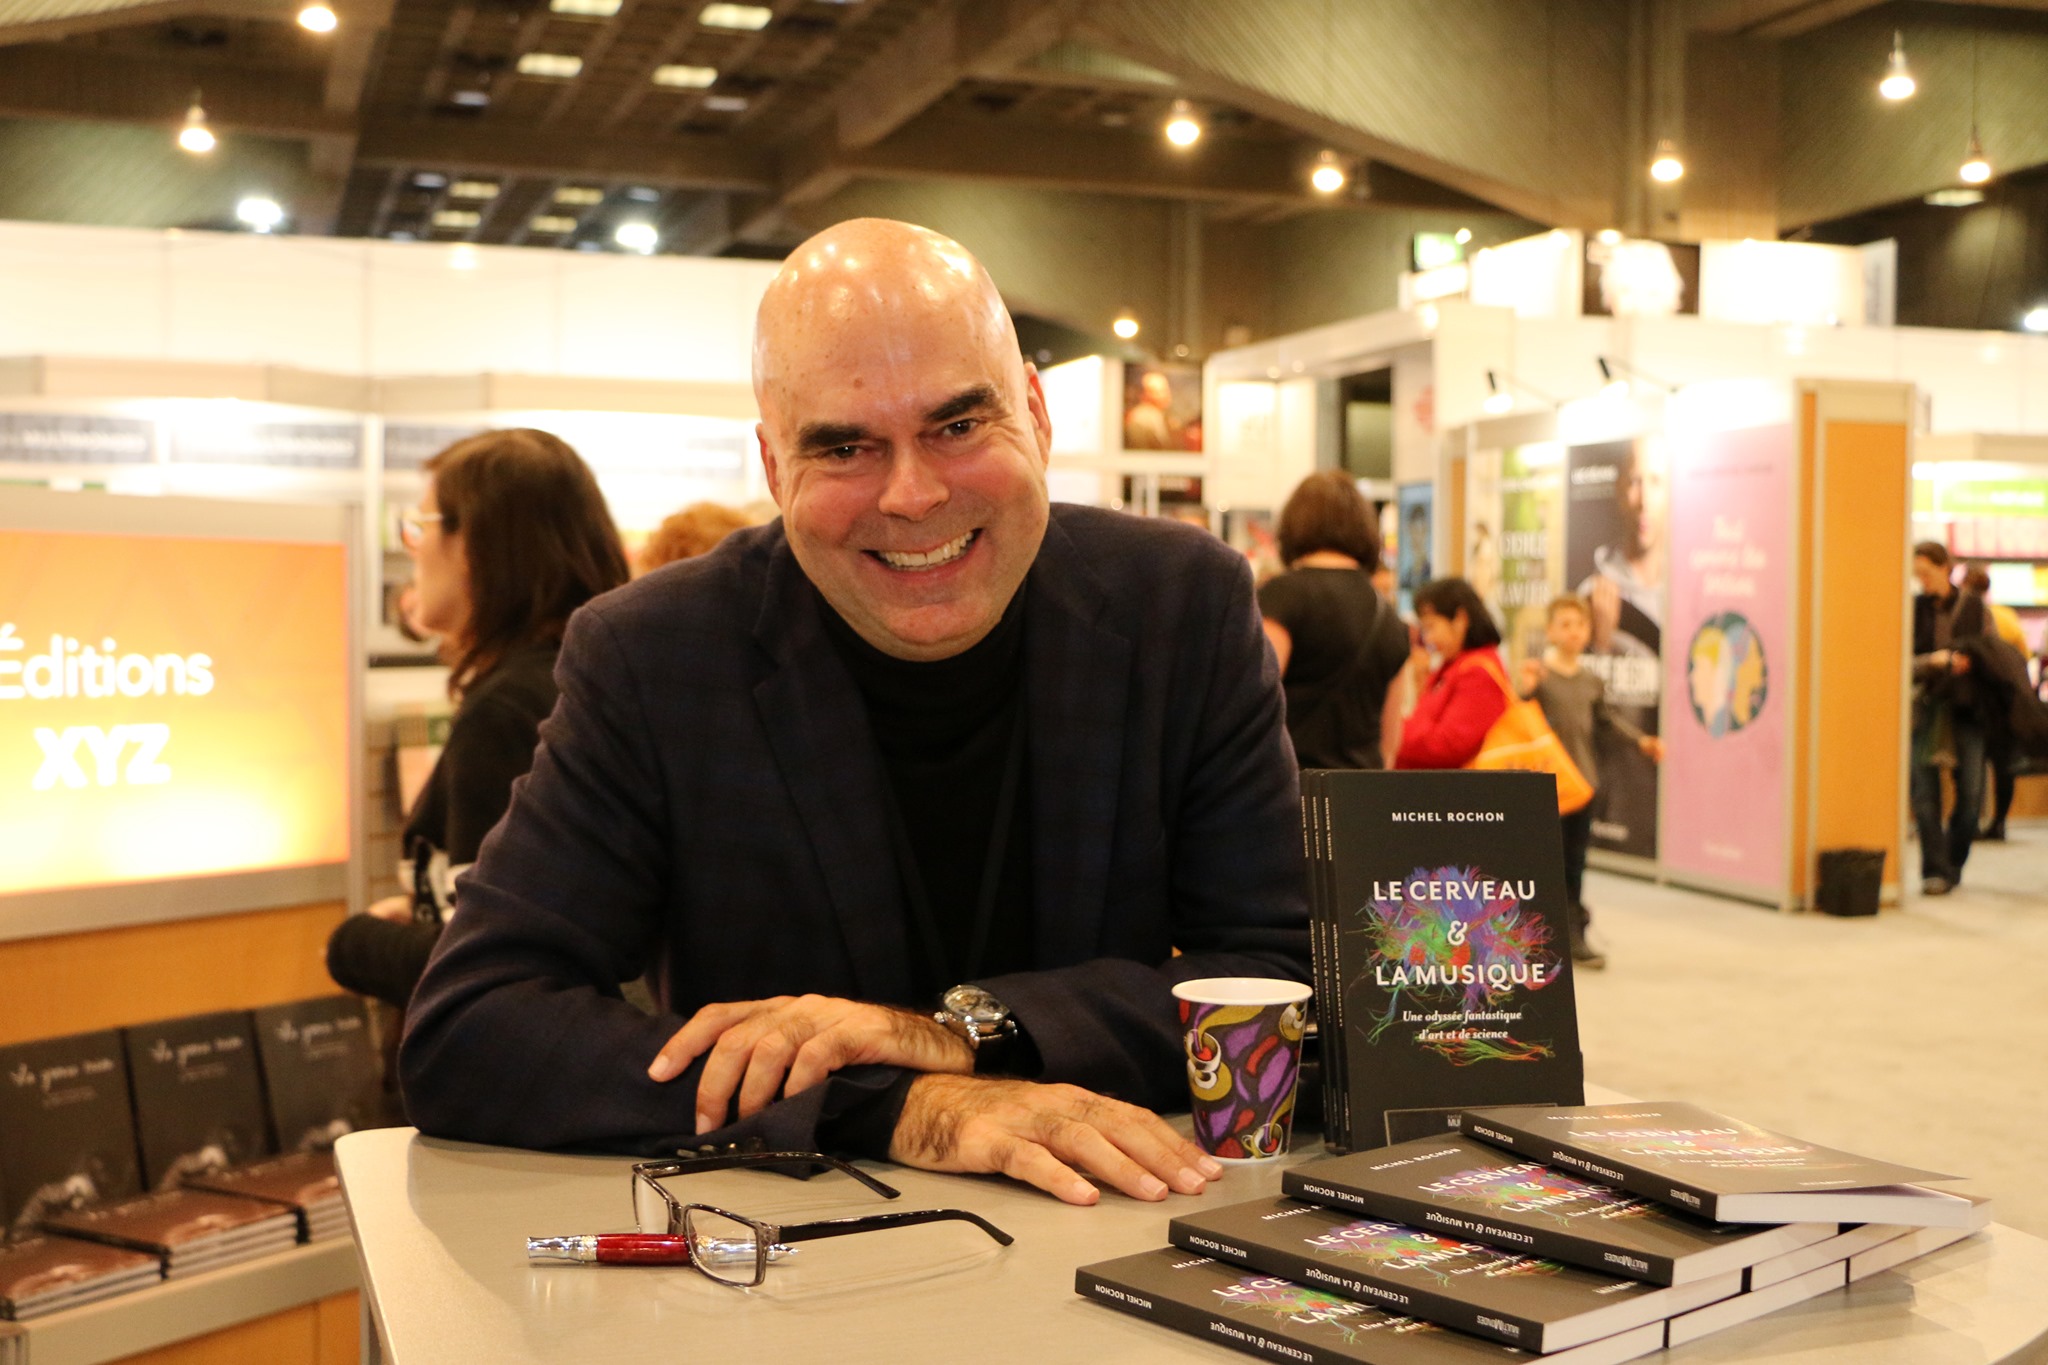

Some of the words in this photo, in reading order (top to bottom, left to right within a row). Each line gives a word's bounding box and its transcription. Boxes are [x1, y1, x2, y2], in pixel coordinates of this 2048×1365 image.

[0, 623, 214, 700] Éditions
[32, 722, 173, 791] XYZ
[1391, 812, 1442, 822] MICHEL
[1447, 812, 1505, 822] ROCHON
[1373, 880, 1402, 901] LE
[1409, 880, 1536, 901] CERVEAU
[1447, 920, 1468, 946] &
[1375, 965, 1410, 986] LA
[1415, 963, 1546, 991] MUSIQUE
[1402, 1010, 1423, 1022] Une
[1425, 1010, 1463, 1024] odyssée
[1463, 1010, 1522, 1024] fantastique
[1418, 1028, 1444, 1041] d'art
[1446, 1029, 1457, 1040] et
[1458, 1028, 1471, 1040] de
[1472, 1029, 1509, 1040] science
[1607, 1127, 1739, 1138] CERVEAU
[1370, 1158, 1414, 1171] MICHEL
[1415, 1148, 1462, 1163] ROCHON
[1552, 1151, 1578, 1166] MUSIQUE
[1591, 1164, 1617, 1179] CERVEAU
[1303, 1183, 1335, 1199] ROCHON
[1418, 1182, 1456, 1193] LE
[1516, 1181, 1545, 1191] &
[1337, 1191, 1364, 1205] MICHEL
[1260, 1206, 1311, 1221] MICHEL
[1500, 1200, 1538, 1213] LA
[1426, 1212, 1463, 1226] MUSIQUE
[1463, 1220, 1475, 1230] LA
[1475, 1222, 1484, 1234] &
[1485, 1227, 1522, 1242] CERVEAU
[1189, 1235, 1219, 1250] ROCHON
[1304, 1234, 1345, 1246] LE
[1409, 1232, 1438, 1244] &
[1522, 1234, 1534, 1245] LE
[1221, 1243, 1247, 1258] MICHEL
[1171, 1256, 1216, 1270] MICHE
[1382, 1257, 1428, 1270] LA
[1305, 1268, 1341, 1285] MUSIQUE
[1342, 1278, 1352, 1287] LA
[1095, 1284, 1126, 1300] ROCHON
[1212, 1284, 1254, 1298] LE
[1353, 1281, 1361, 1292] &
[1362, 1285, 1399, 1301] CERVEAU
[1126, 1293, 1152, 1309] MICHEL
[1398, 1295, 1409, 1305] LE
[1290, 1310, 1337, 1324] LA
[1209, 1321, 1246, 1341] MUSIQUE
[1246, 1334, 1256, 1344] LA
[1257, 1337, 1266, 1349] &
[1266, 1342, 1303, 1359] CERVEAU
[1303, 1352, 1313, 1363] LE
